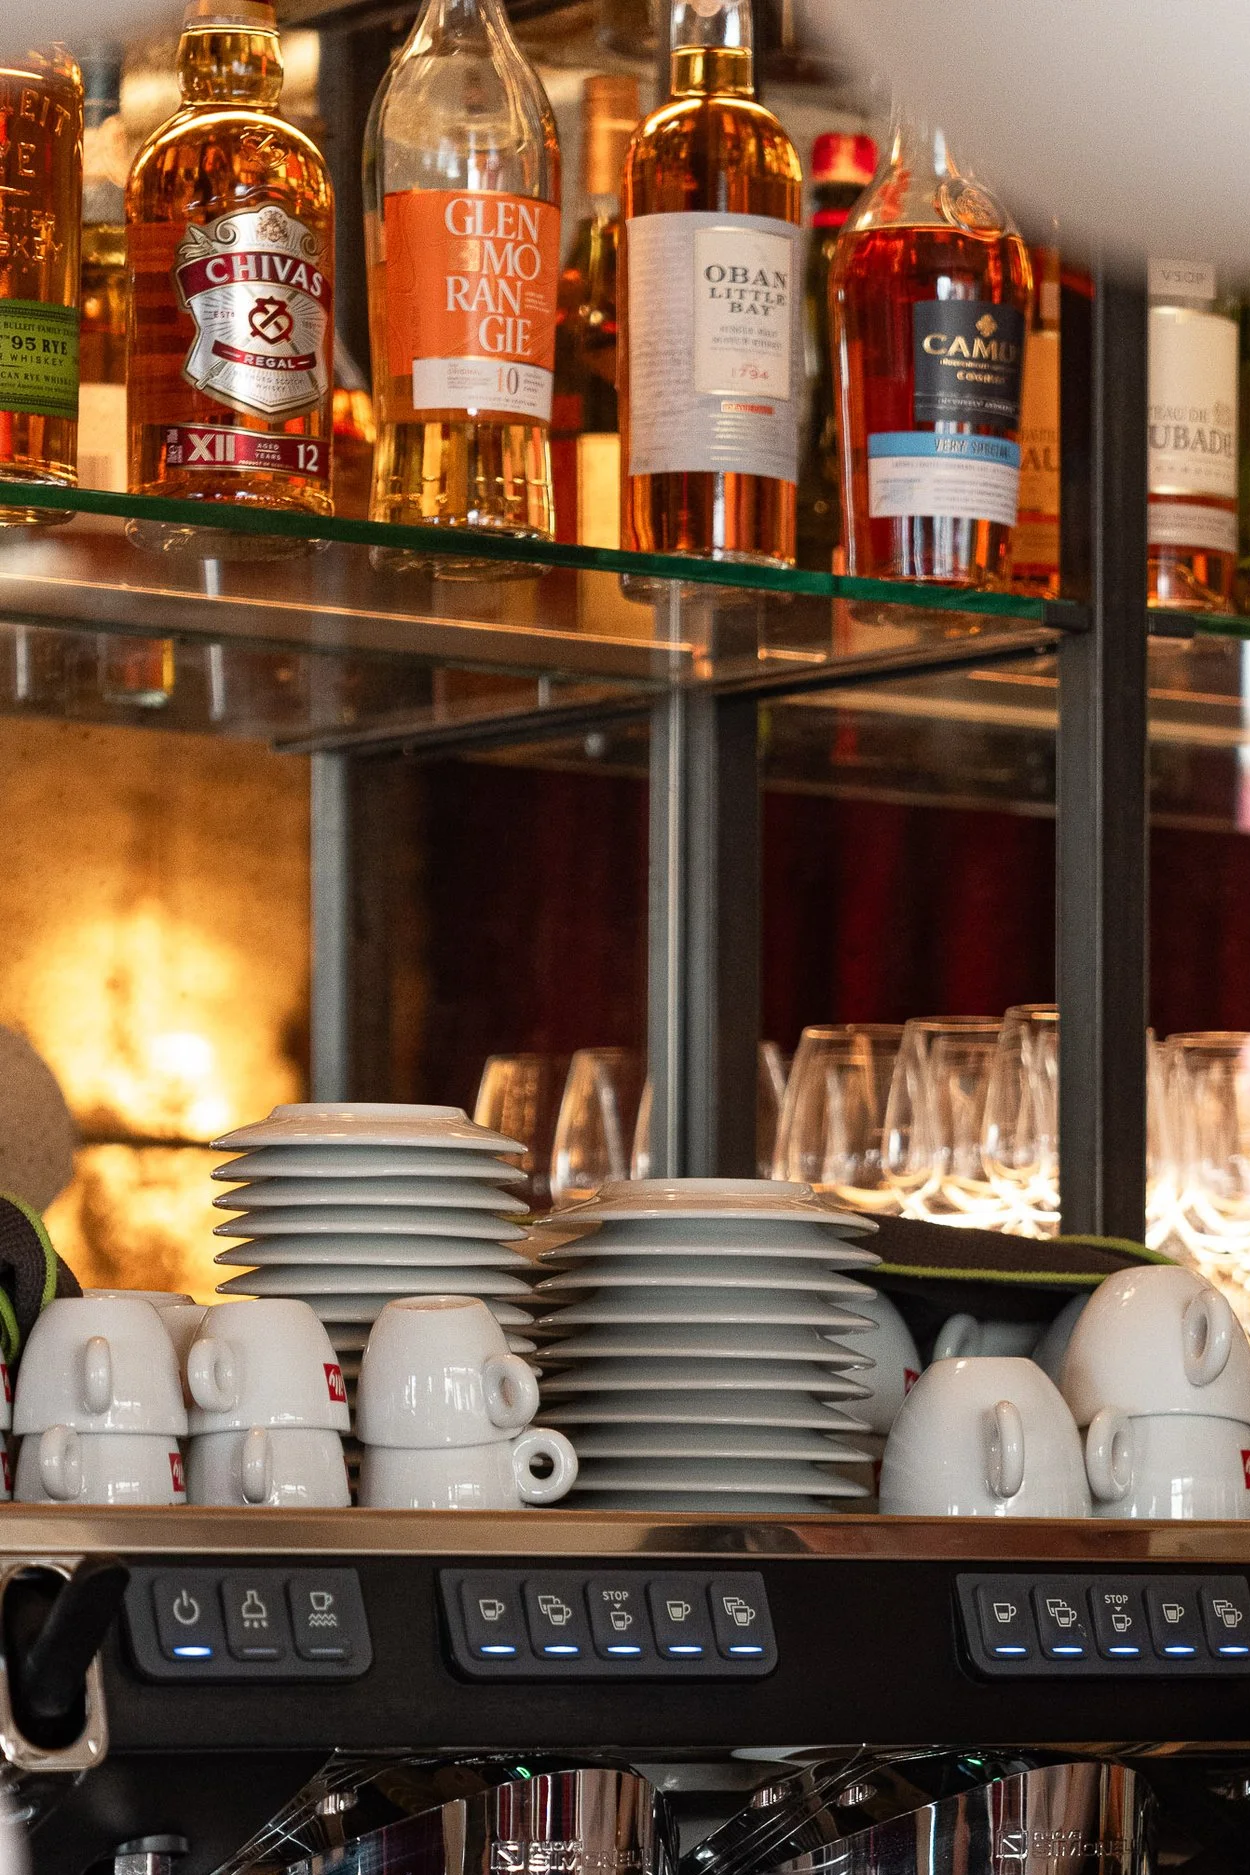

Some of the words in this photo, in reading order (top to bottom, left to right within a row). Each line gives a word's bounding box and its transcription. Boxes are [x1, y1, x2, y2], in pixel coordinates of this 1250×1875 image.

[444, 197, 541, 244] GLEN
[481, 239, 542, 281] MO
[205, 253, 324, 298] CHIVAS
[705, 264, 787, 290] OBAN
[445, 275, 524, 316] RAN
[709, 287, 785, 306] LITTLE
[728, 302, 774, 316] BAY
[11, 335, 36, 351] 95
[42, 338, 68, 356] RYE
[478, 314, 533, 356] GIE
[10, 353, 64, 367] WHISKEY
[244, 353, 296, 370] REGAL
[497, 366, 519, 396] 10
[187, 433, 236, 462] XII
[256, 442, 280, 451] AGED
[256, 452, 282, 461] YEARS
[296, 443, 320, 473] 12
[602, 1591, 629, 1601] STOP
[1104, 1594, 1129, 1604] STOP
